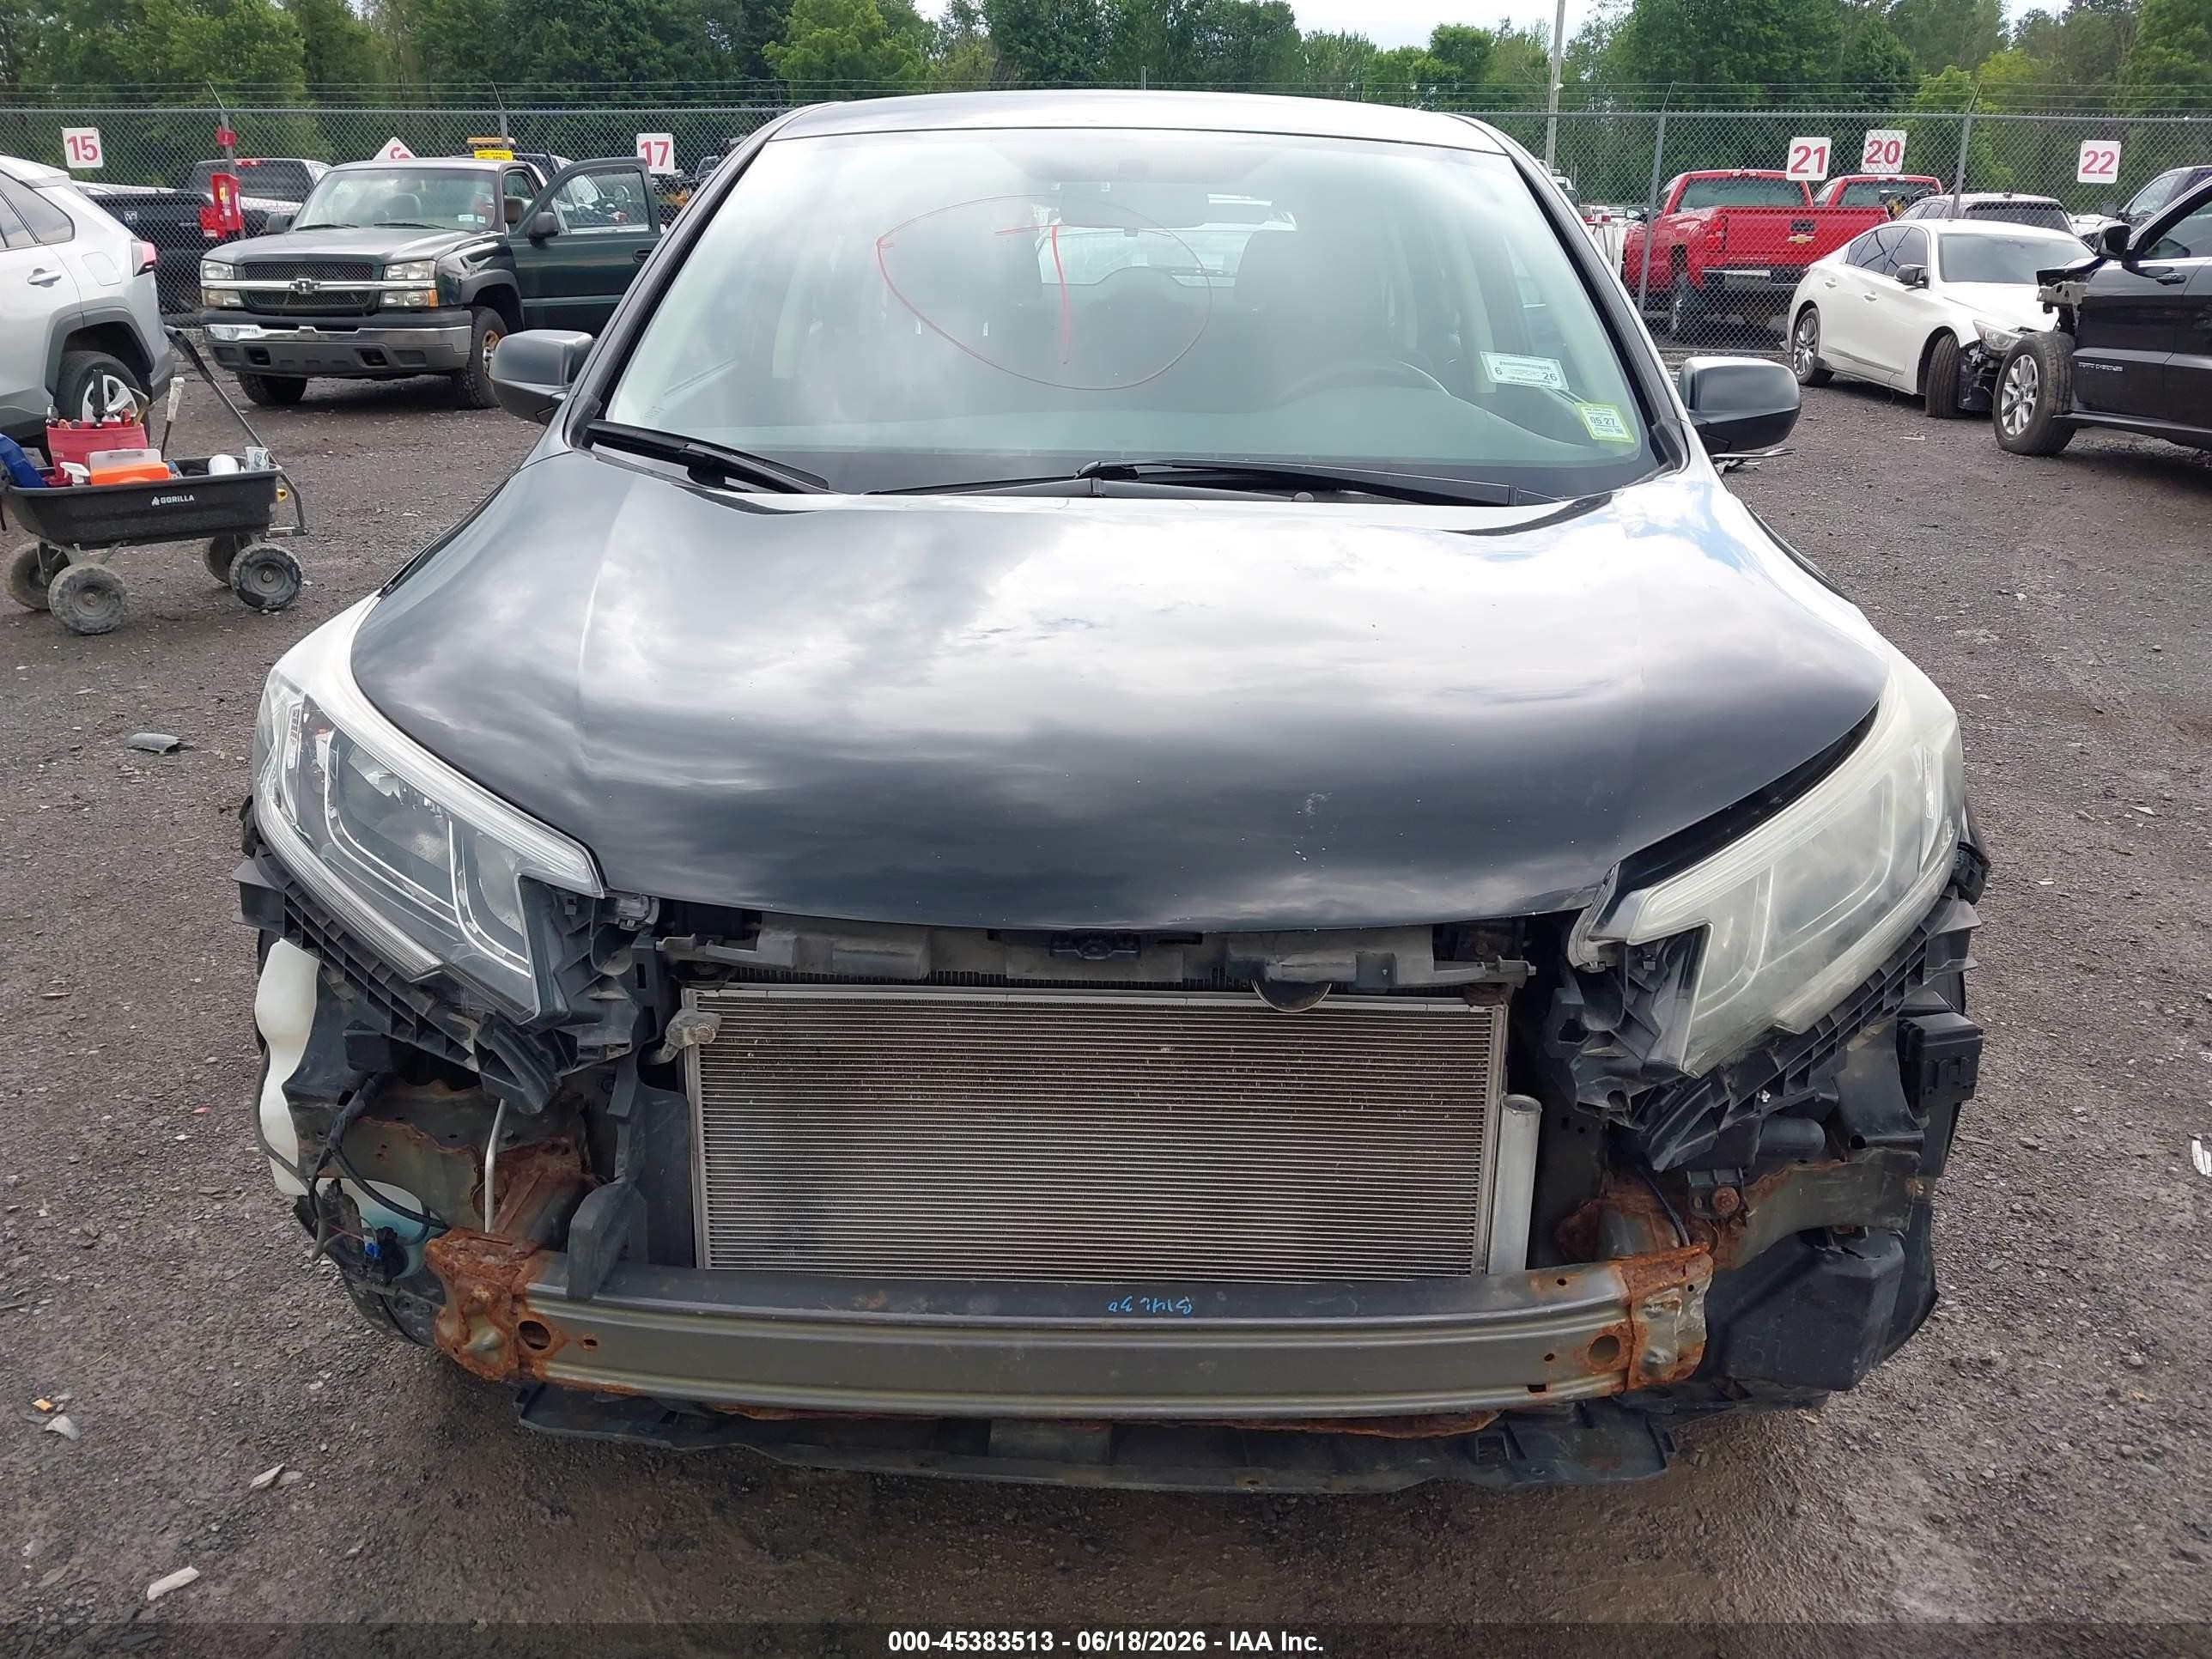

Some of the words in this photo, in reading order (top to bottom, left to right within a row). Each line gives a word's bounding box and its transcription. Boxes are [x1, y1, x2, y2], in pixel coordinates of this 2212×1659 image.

[66, 136, 98, 161] 15
[640, 141, 670, 167] 17
[1790, 145, 1826, 174] 21
[1865, 139, 1901, 165] 20
[2081, 149, 2116, 174] 22
[1541, 372, 1558, 381] 26
[160, 495, 195, 504] GORILLA
